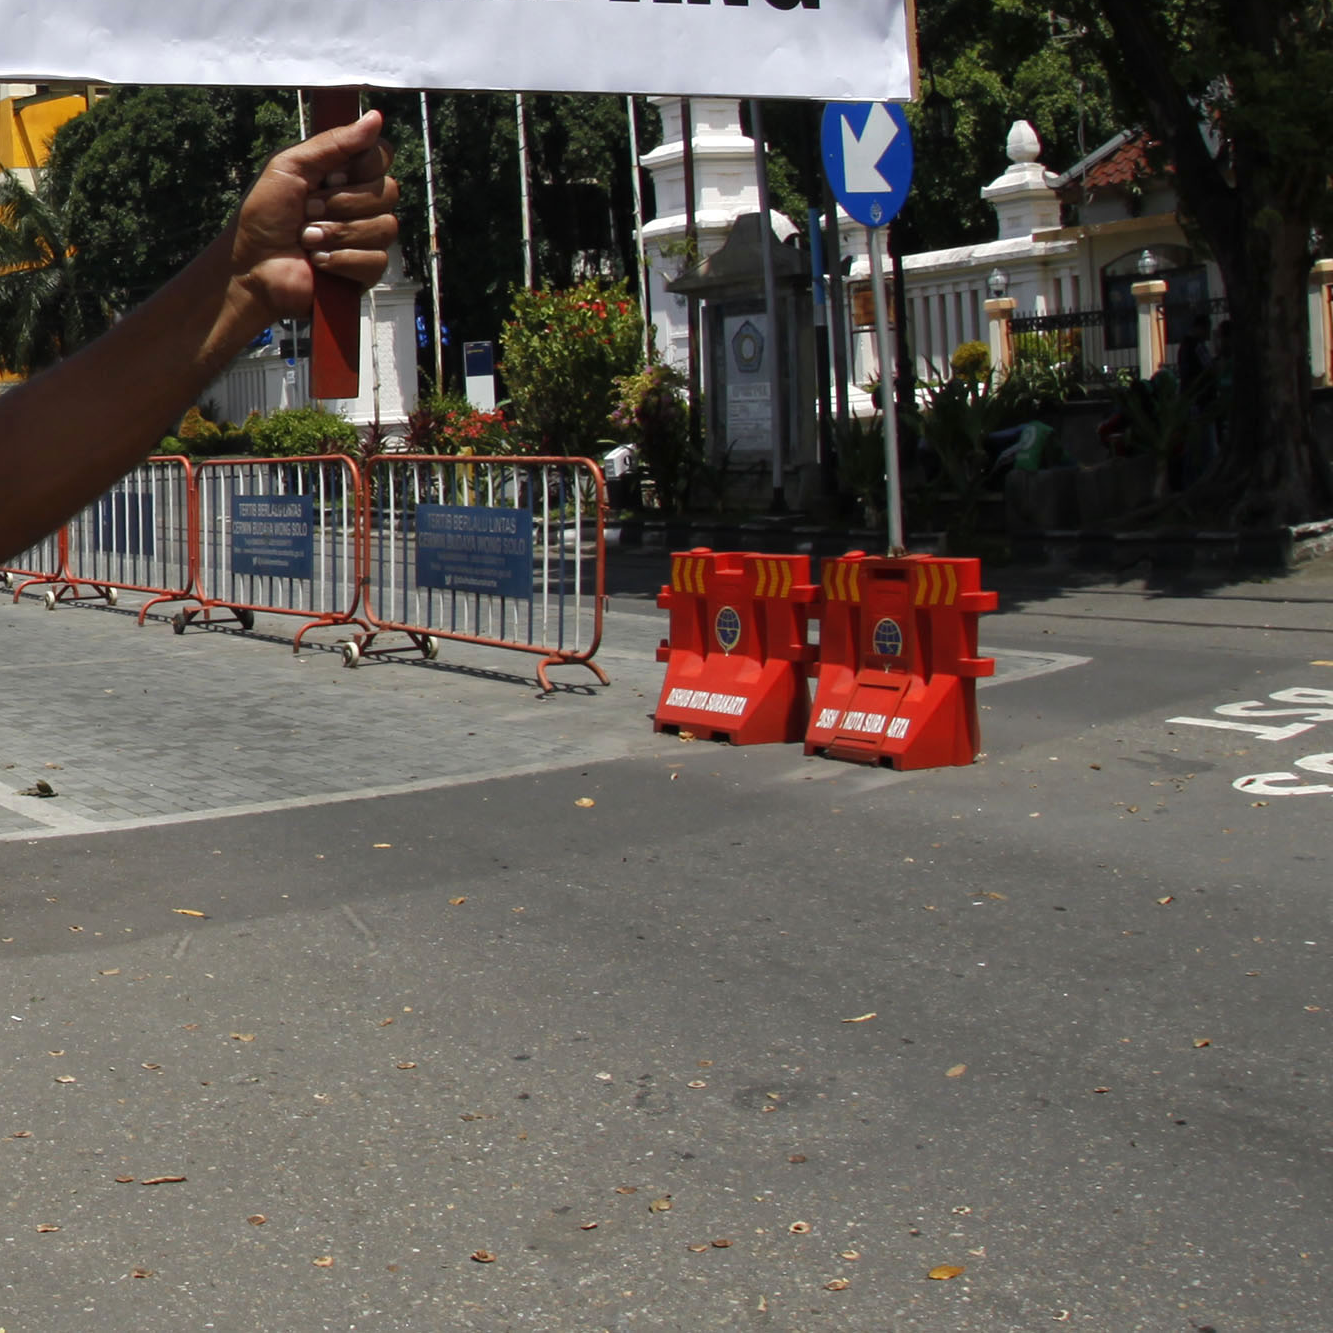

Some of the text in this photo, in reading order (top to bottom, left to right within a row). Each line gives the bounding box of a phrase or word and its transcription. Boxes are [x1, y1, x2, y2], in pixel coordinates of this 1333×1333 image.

[292, 522, 307, 536] SOLO
[489, 516, 517, 534] LINTAS
[666, 688, 747, 716] DISHUB KOTA SURAKARTA
[816, 708, 841, 728] DISH
[861, 713, 910, 738] SURAARTA
